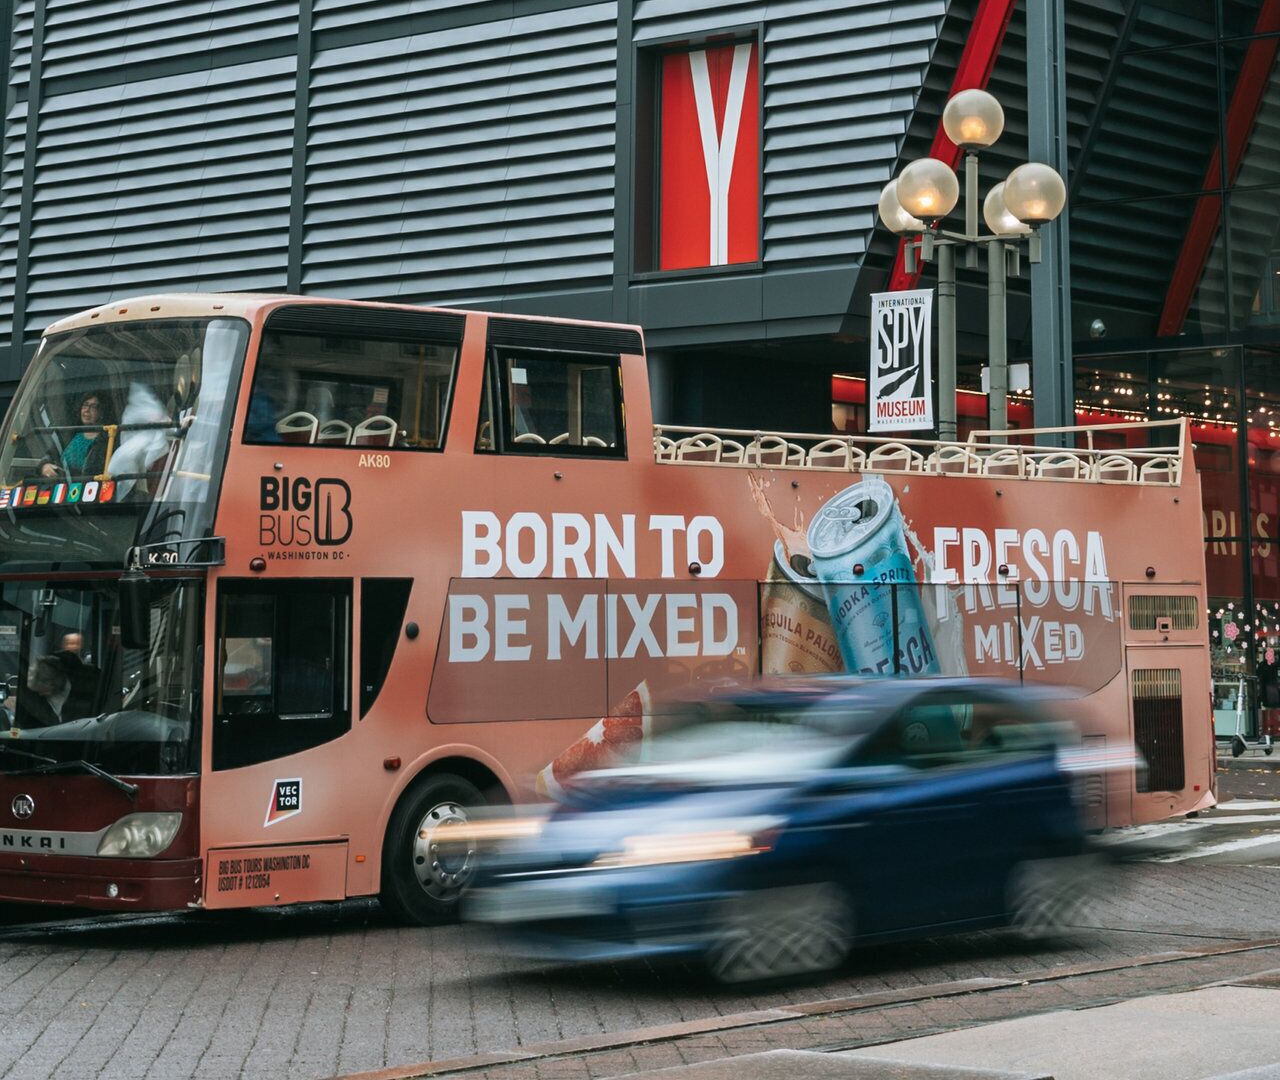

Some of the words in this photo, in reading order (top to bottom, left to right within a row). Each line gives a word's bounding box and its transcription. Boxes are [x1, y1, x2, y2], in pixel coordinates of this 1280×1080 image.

[878, 297, 926, 309] INTERNATIONAL
[877, 307, 926, 369] SPY
[877, 400, 926, 418] MUSEUM
[358, 454, 391, 468] AK80
[260, 476, 312, 512] BIG
[260, 514, 312, 546] BUS
[461, 510, 636, 578] BORN
[649, 514, 724, 578] TO
[268, 552, 329, 560] WASHINGTON
[332, 552, 344, 560] DC
[931, 526, 1115, 622] FRESCA
[835, 586, 869, 625] VODKA
[872, 567, 911, 590] SPRITZ
[448, 594, 532, 663] BE
[547, 593, 738, 660] MIXED
[974, 615, 1085, 671] MIXED
[219, 861, 229, 875] BIG
[230, 860, 241, 874] BUS
[243, 858, 262, 873] TOURS
[263, 855, 301, 872] WASHINGTON
[302, 854, 310, 869] DC
